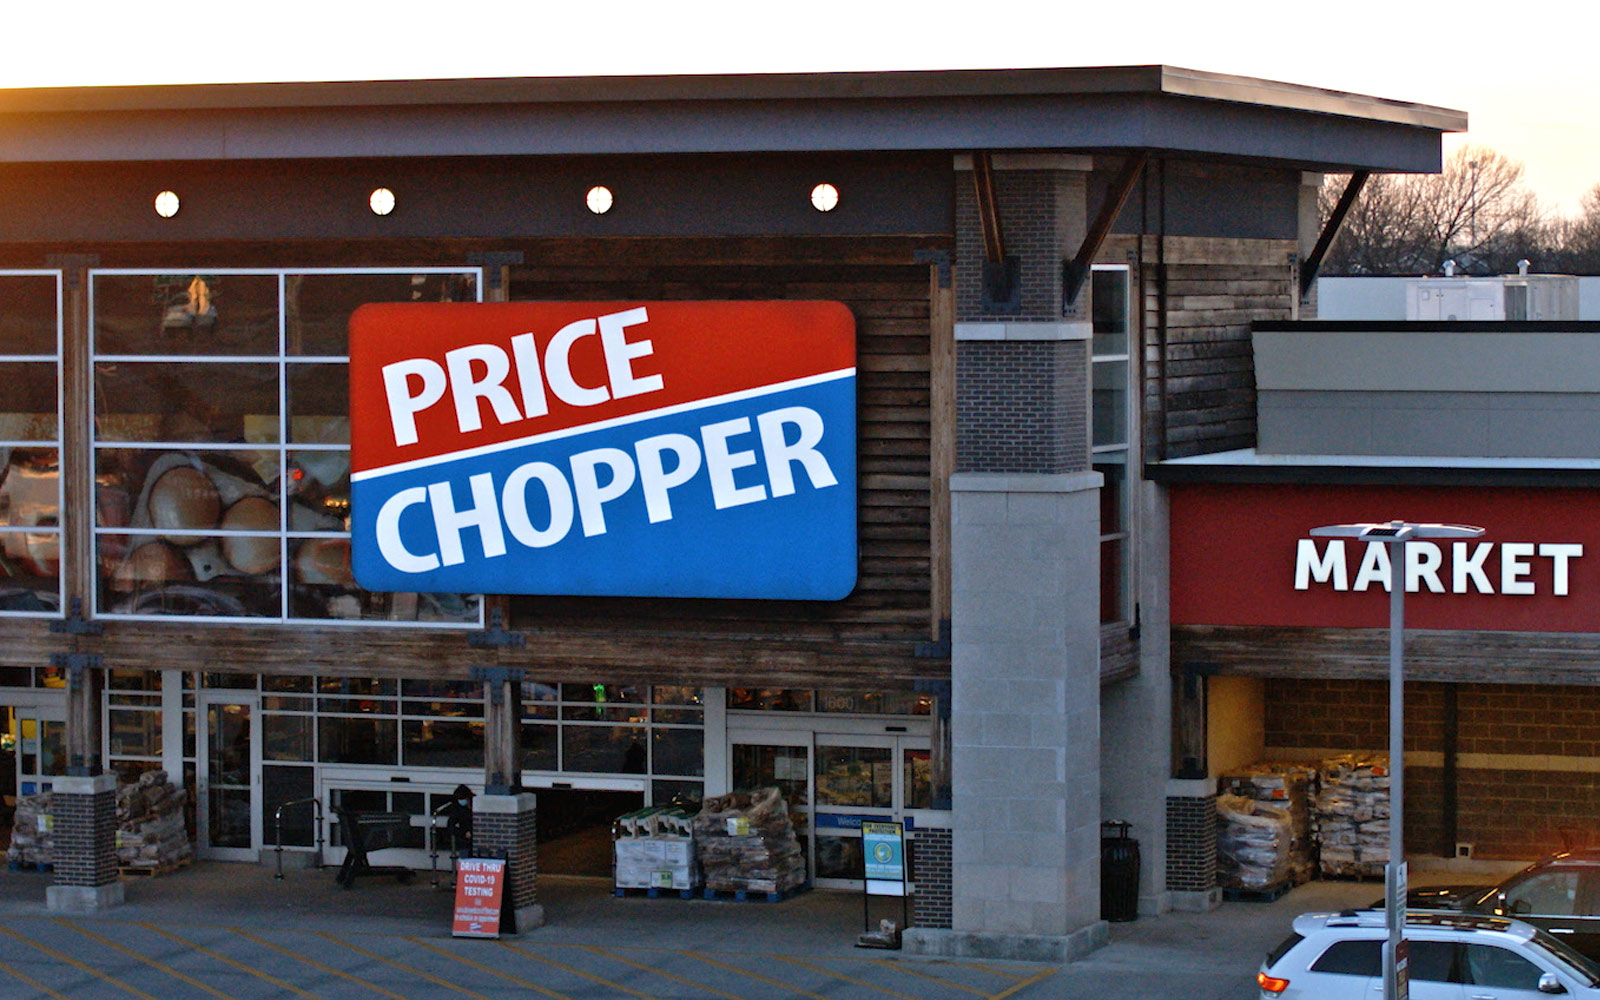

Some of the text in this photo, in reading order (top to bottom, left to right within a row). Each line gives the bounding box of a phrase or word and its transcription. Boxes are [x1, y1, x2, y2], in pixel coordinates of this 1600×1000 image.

[382, 307, 664, 447] PRICE
[376, 406, 839, 574] CHOPPER
[1294, 539, 1584, 596] MARKET
[837, 816, 862, 826] Welco
[461, 862, 500, 872] DRIVE THRU
[464, 874, 495, 884] COVID-19
[464, 886, 493, 897] TESTING
